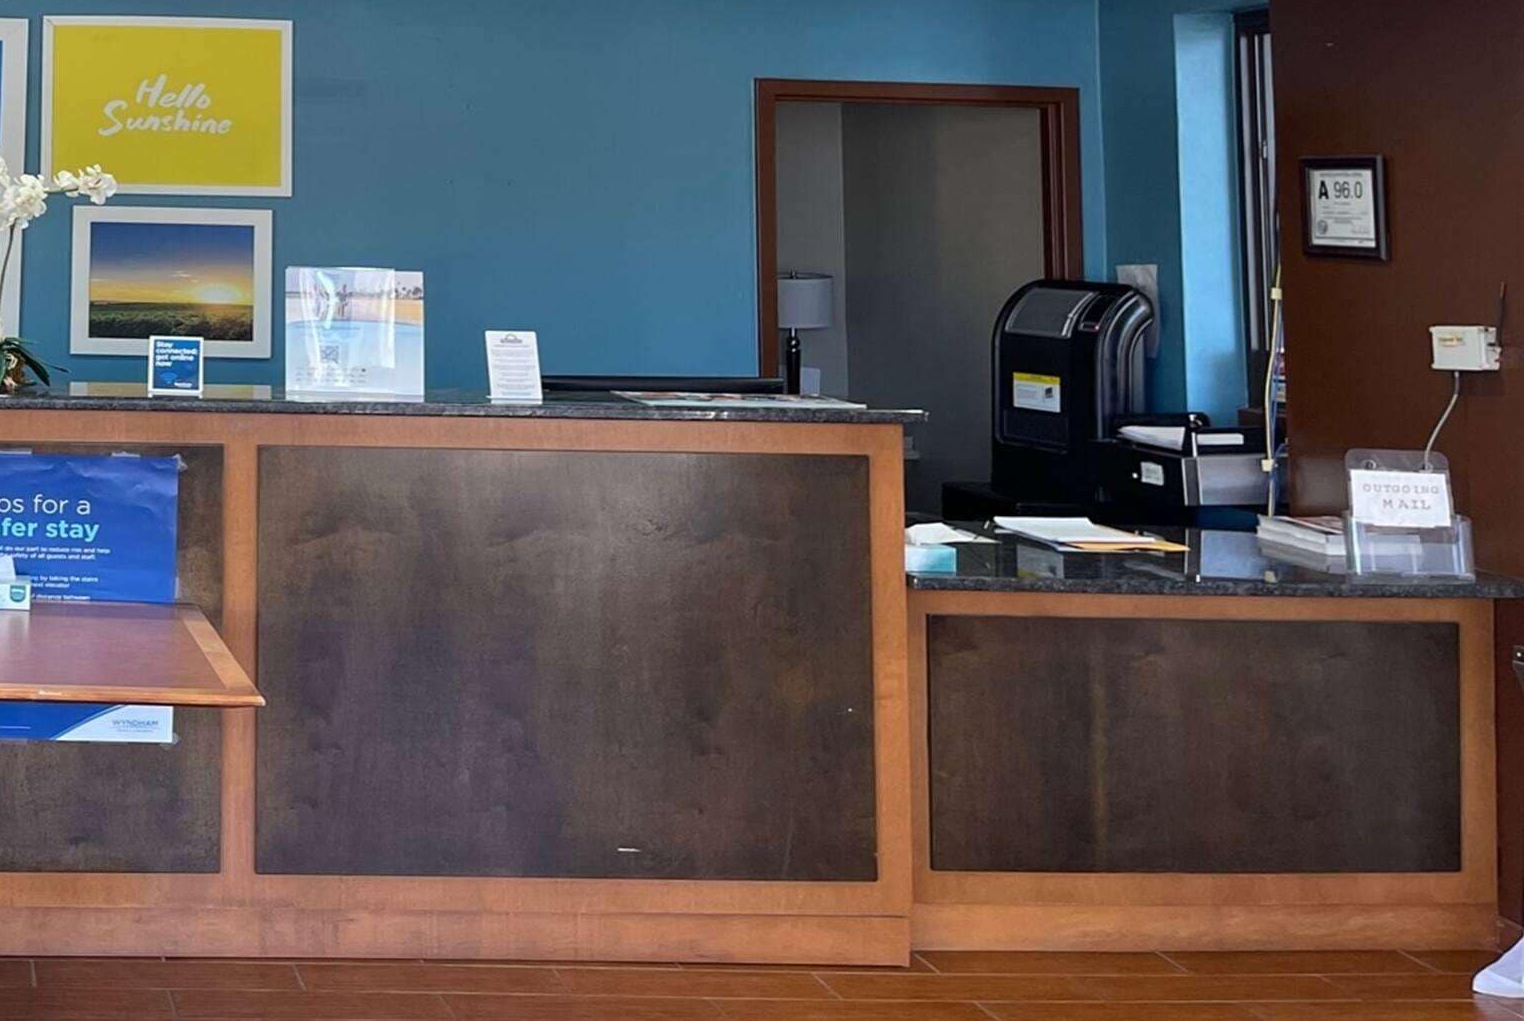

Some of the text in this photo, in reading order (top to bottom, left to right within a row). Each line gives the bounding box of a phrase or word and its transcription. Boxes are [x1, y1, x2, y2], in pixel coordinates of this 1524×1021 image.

[135, 74, 212, 110] Hello
[97, 99, 233, 136] Sunshine
[1318, 180, 1363, 199] A 96.0
[1362, 483, 1440, 495] OUTGOING
[33, 494, 69, 514] for
[76, 499, 91, 515] a
[1382, 499, 1431, 510] MAIL
[45, 520, 100, 542] stay
